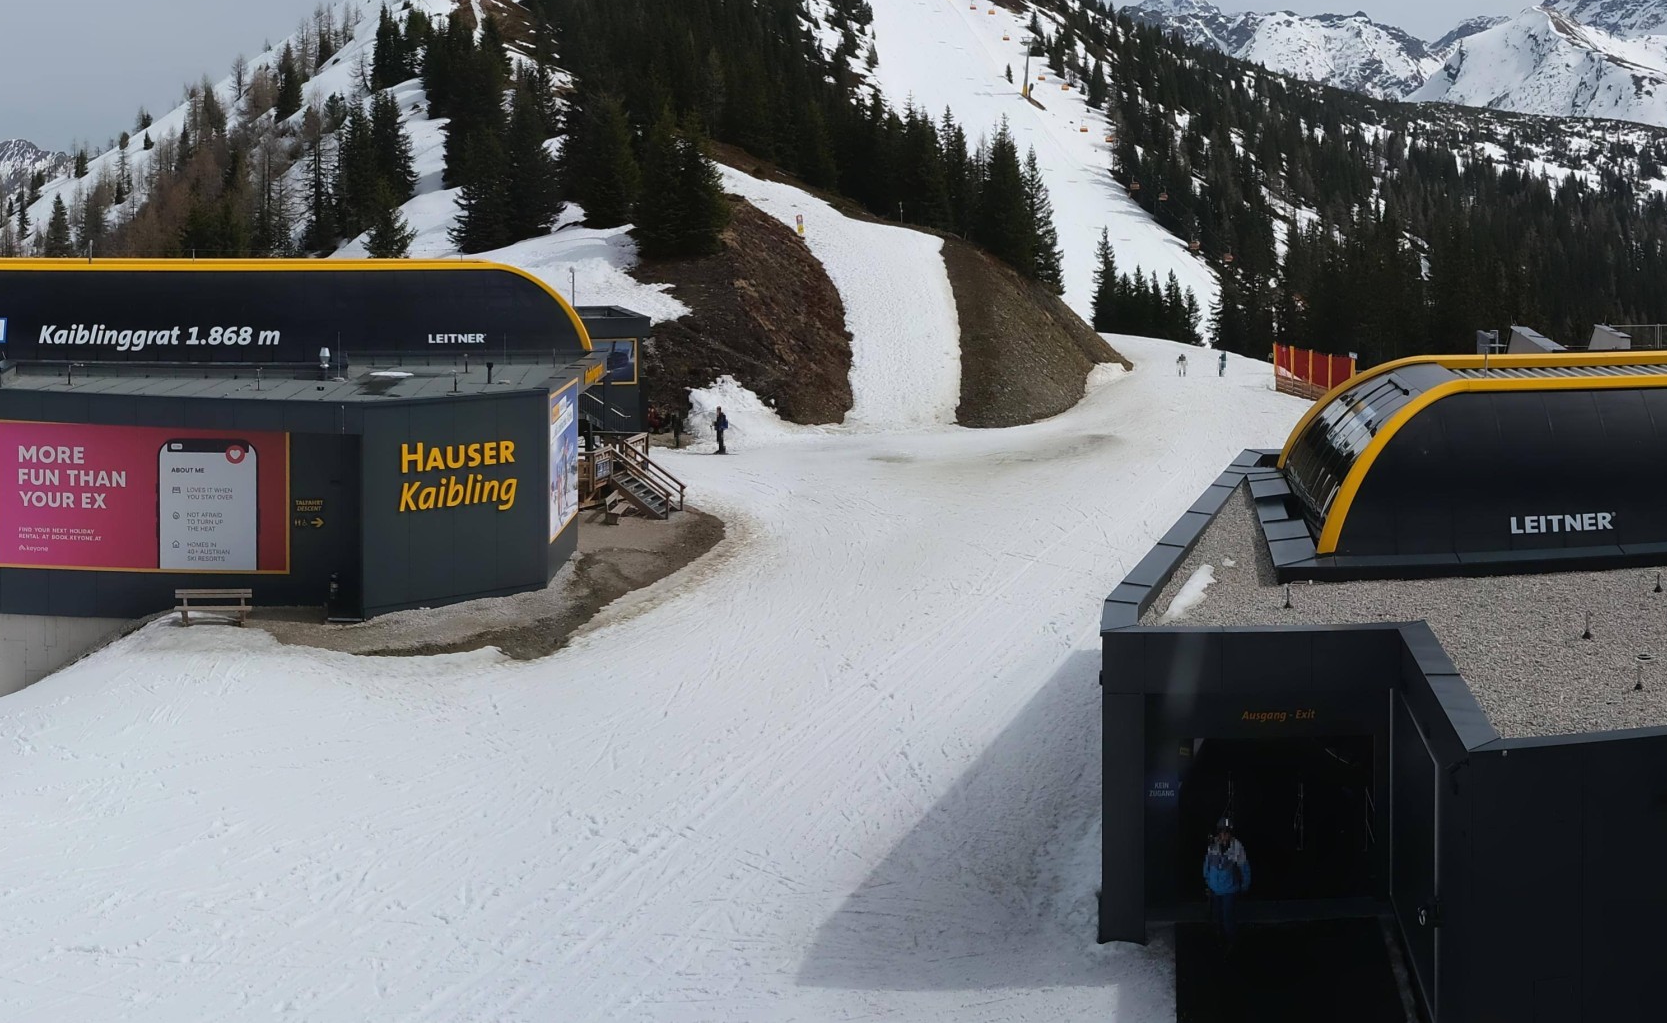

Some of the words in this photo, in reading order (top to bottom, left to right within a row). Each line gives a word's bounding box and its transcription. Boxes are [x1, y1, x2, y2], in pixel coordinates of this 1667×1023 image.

[38, 323, 181, 351] Kaiblinggrat
[185, 325, 251, 345] 1.868
[258, 329, 281, 345] m
[18, 445, 85, 464] MORE
[401, 440, 516, 474] HAUSER
[18, 468, 60, 486] FUN
[67, 469, 126, 488] THAN
[19, 491, 75, 508] YOUR
[81, 492, 107, 509] EX
[399, 474, 518, 512] Kaibling
[26, 545, 49, 553] keyone
[1241, 710, 1287, 723] Ausgang
[1295, 709, 1316, 720] Exit
[1149, 789, 1175, 797] ZUGANG
[1154, 781, 1169, 789] KEIN
